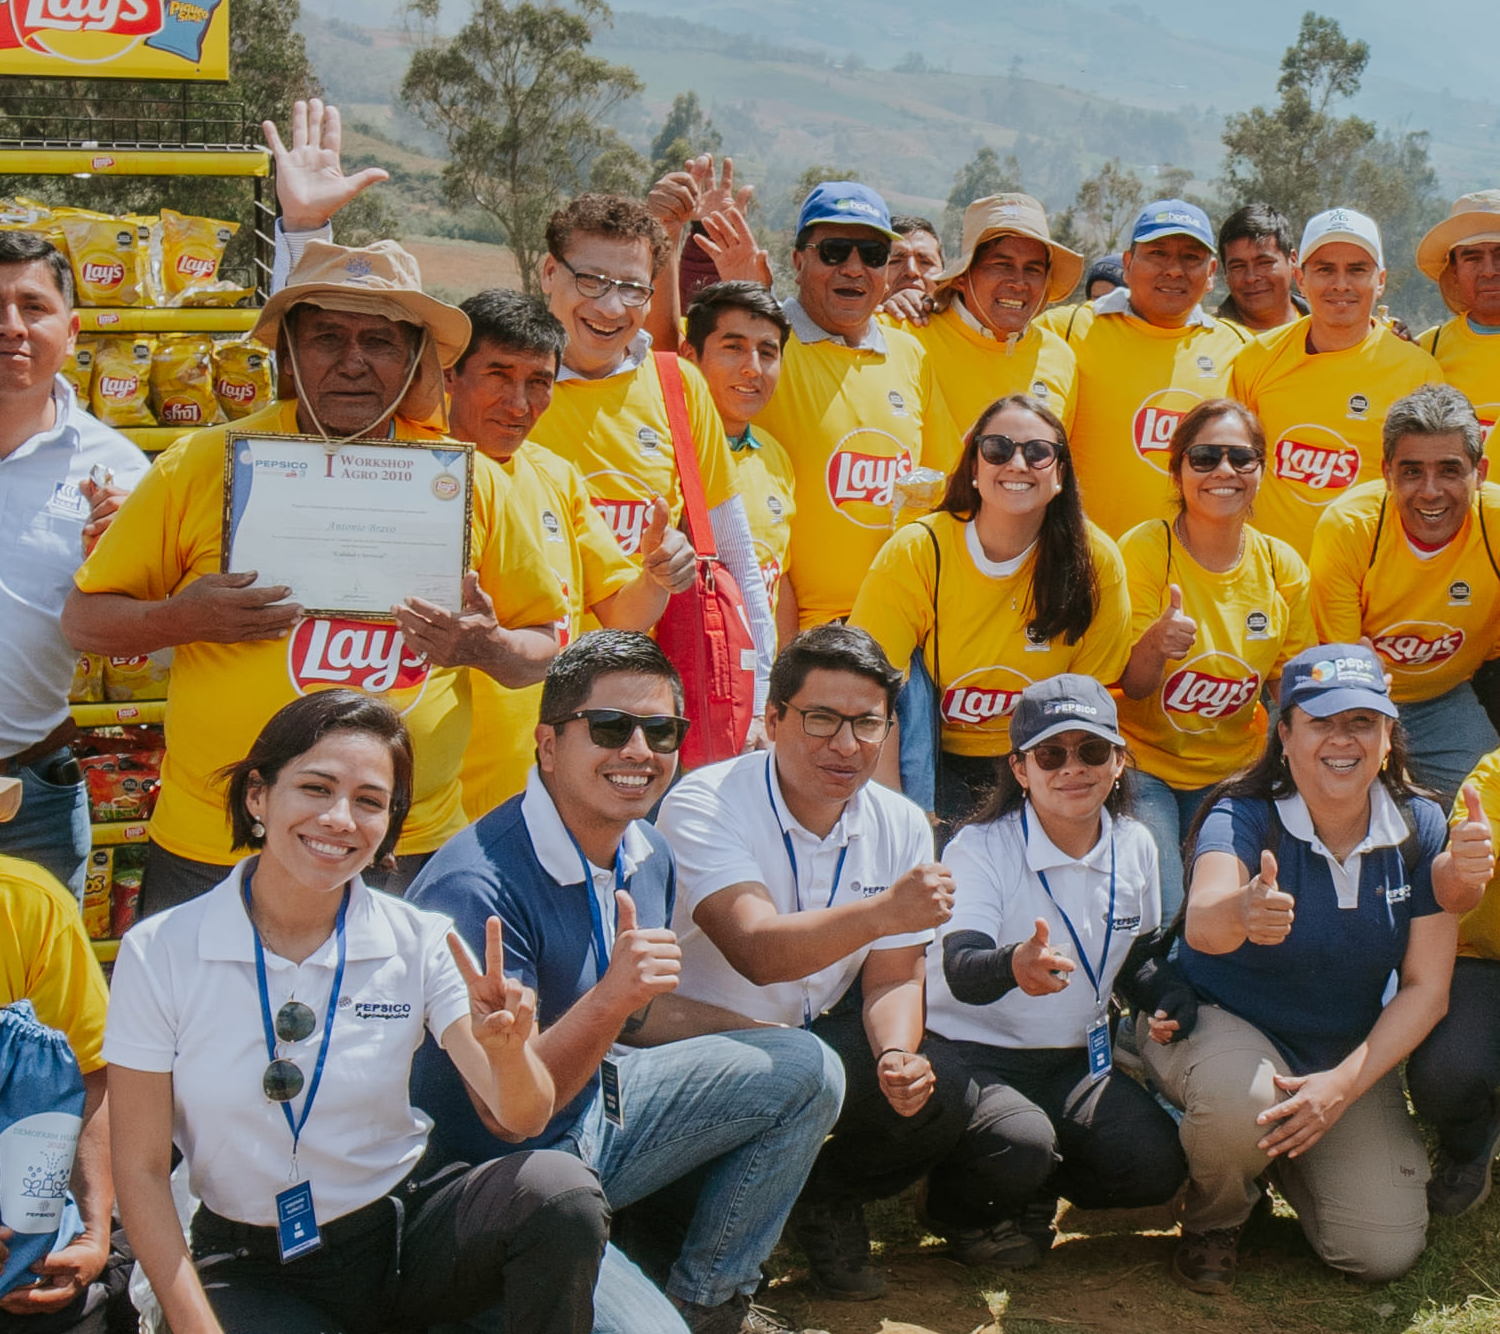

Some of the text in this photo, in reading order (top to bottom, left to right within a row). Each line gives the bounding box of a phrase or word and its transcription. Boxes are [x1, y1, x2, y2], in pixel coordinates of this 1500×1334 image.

[84, 263, 123, 284] Lay's
[179, 255, 215, 276] Lay's
[102, 375, 138, 399] Lay's
[222, 381, 254, 401] Lay's
[255, 459, 308, 470] PEPSICO
[1278, 441, 1357, 489] Lay's
[381, 469, 413, 482] 2010
[299, 619, 427, 693] Lay
[1376, 633, 1462, 665] Lay's
[1165, 671, 1256, 718] Lay's
[1054, 699, 1098, 716] PEPSICO
[355, 1002, 411, 1013] PEPSICO
